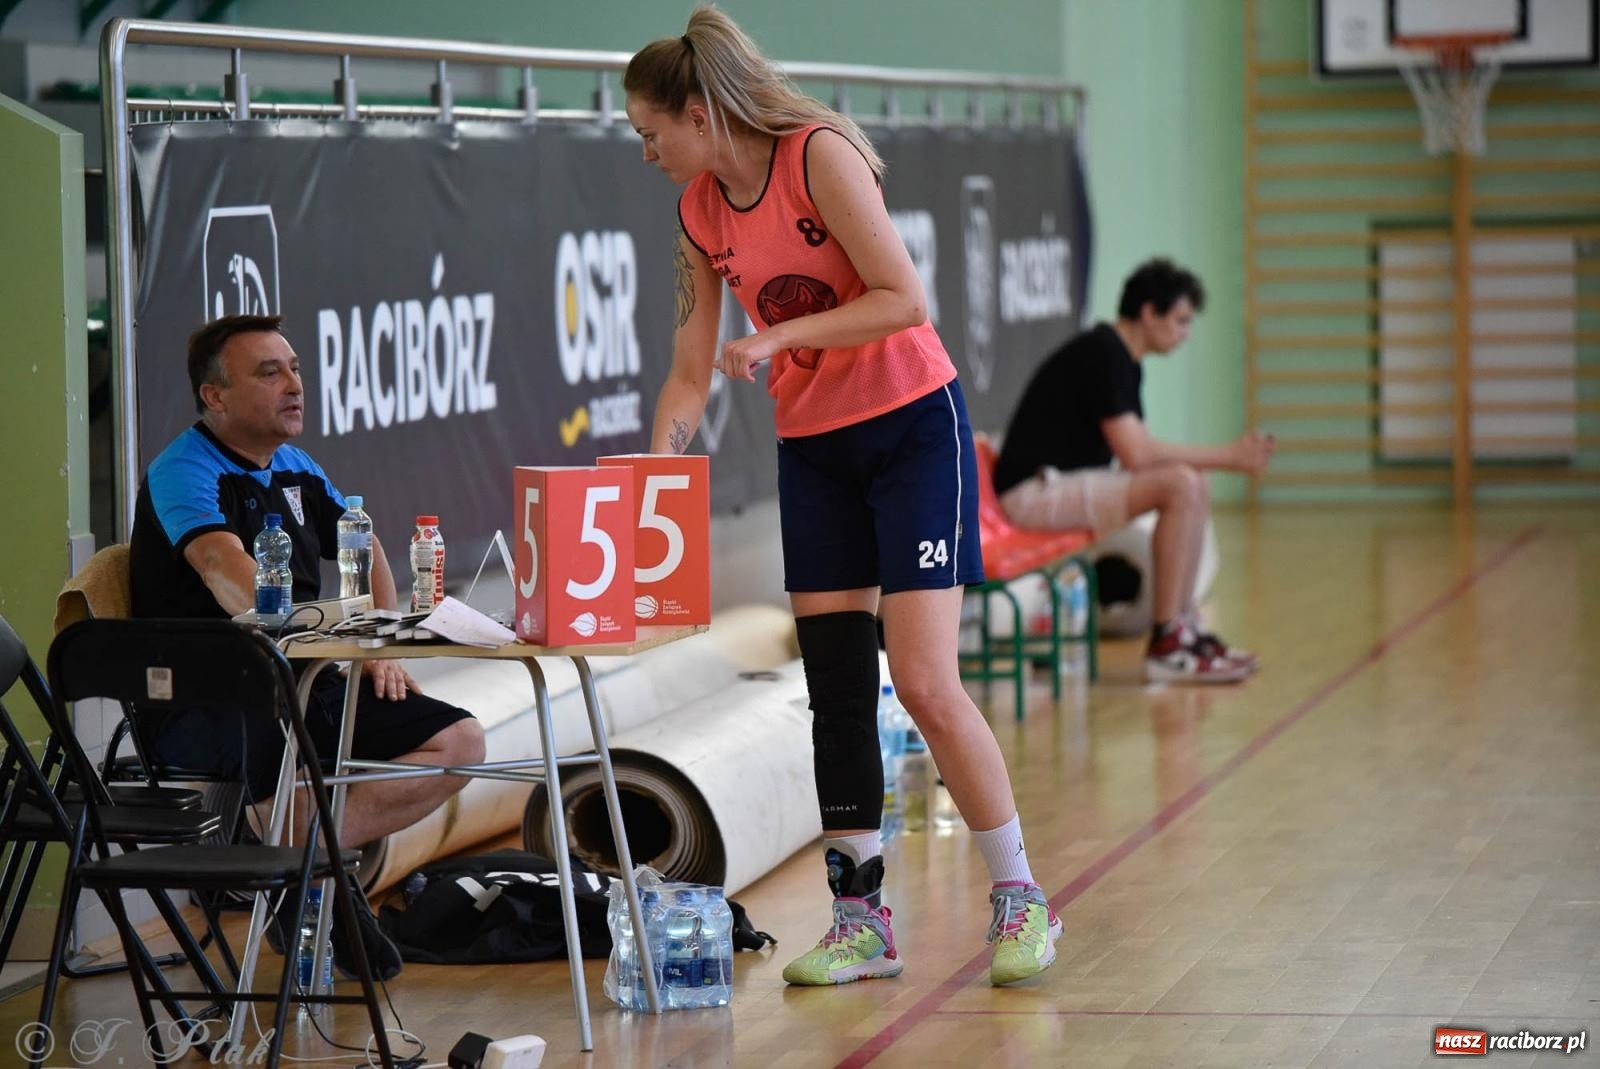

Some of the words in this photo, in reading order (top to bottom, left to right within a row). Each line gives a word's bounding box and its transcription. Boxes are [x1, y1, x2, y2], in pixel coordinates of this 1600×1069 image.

[796, 217, 828, 247] 8
[317, 252, 497, 436] RACIBÓRZ
[519, 487, 540, 599] 5
[565, 485, 626, 601] 5
[633, 475, 691, 584] 5
[918, 539, 949, 569] 24
